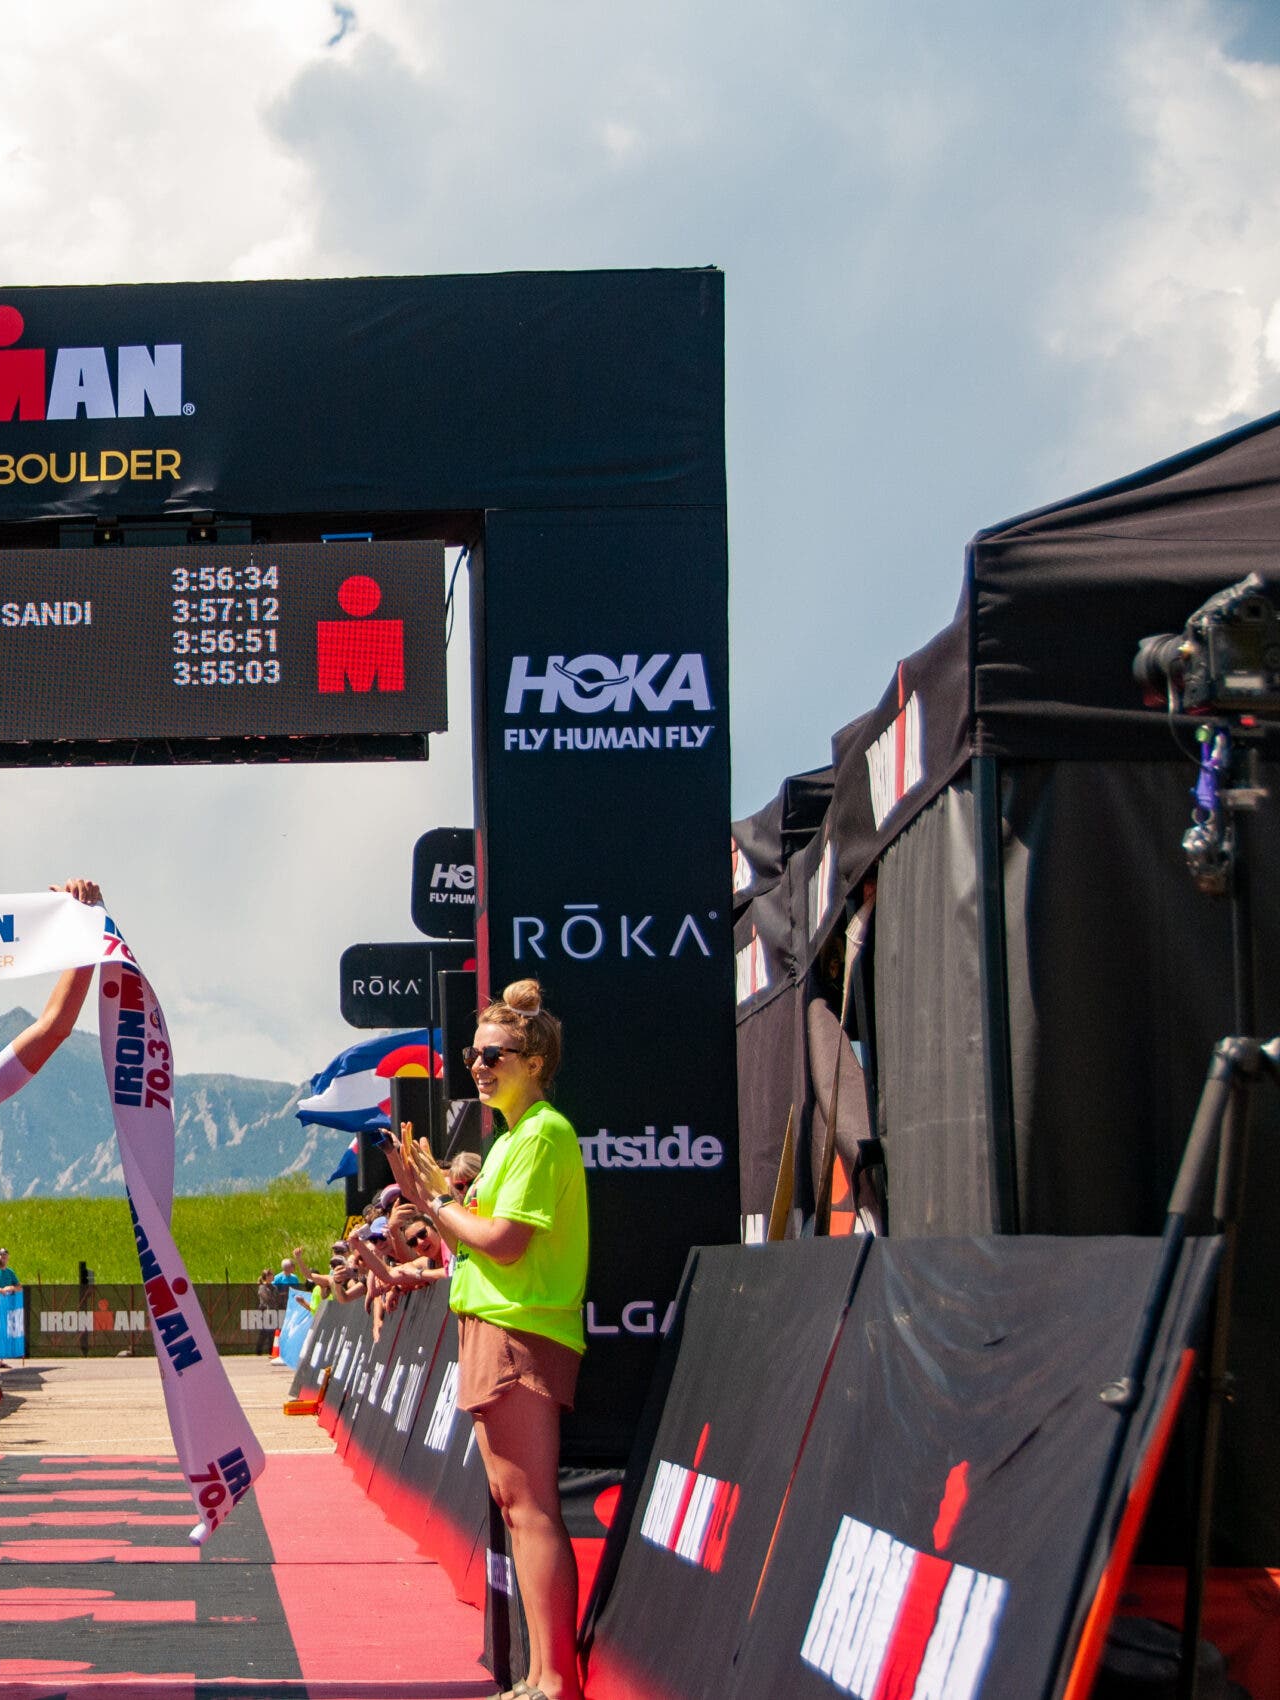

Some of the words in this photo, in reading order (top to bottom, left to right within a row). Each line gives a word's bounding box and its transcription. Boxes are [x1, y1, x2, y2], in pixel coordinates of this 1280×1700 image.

[171, 565, 279, 592] 3:56:34
[1, 601, 92, 627] SANDI
[172, 597, 280, 624] 3:57:12
[172, 628, 278, 655] 3:56:51
[172, 659, 281, 686] 3:55:03
[504, 653, 712, 714] HOKA
[504, 728, 548, 751] FLY
[554, 726, 660, 750] HUMAN
[665, 726, 710, 748] FLY
[430, 863, 476, 890] HO
[429, 892, 449, 903] FLY
[449, 893, 476, 904] HUM
[145, 1038, 171, 1111] 70.3
[40, 1310, 147, 1333] IRONMAN
[800, 1513, 1008, 1700] IRONMAN
